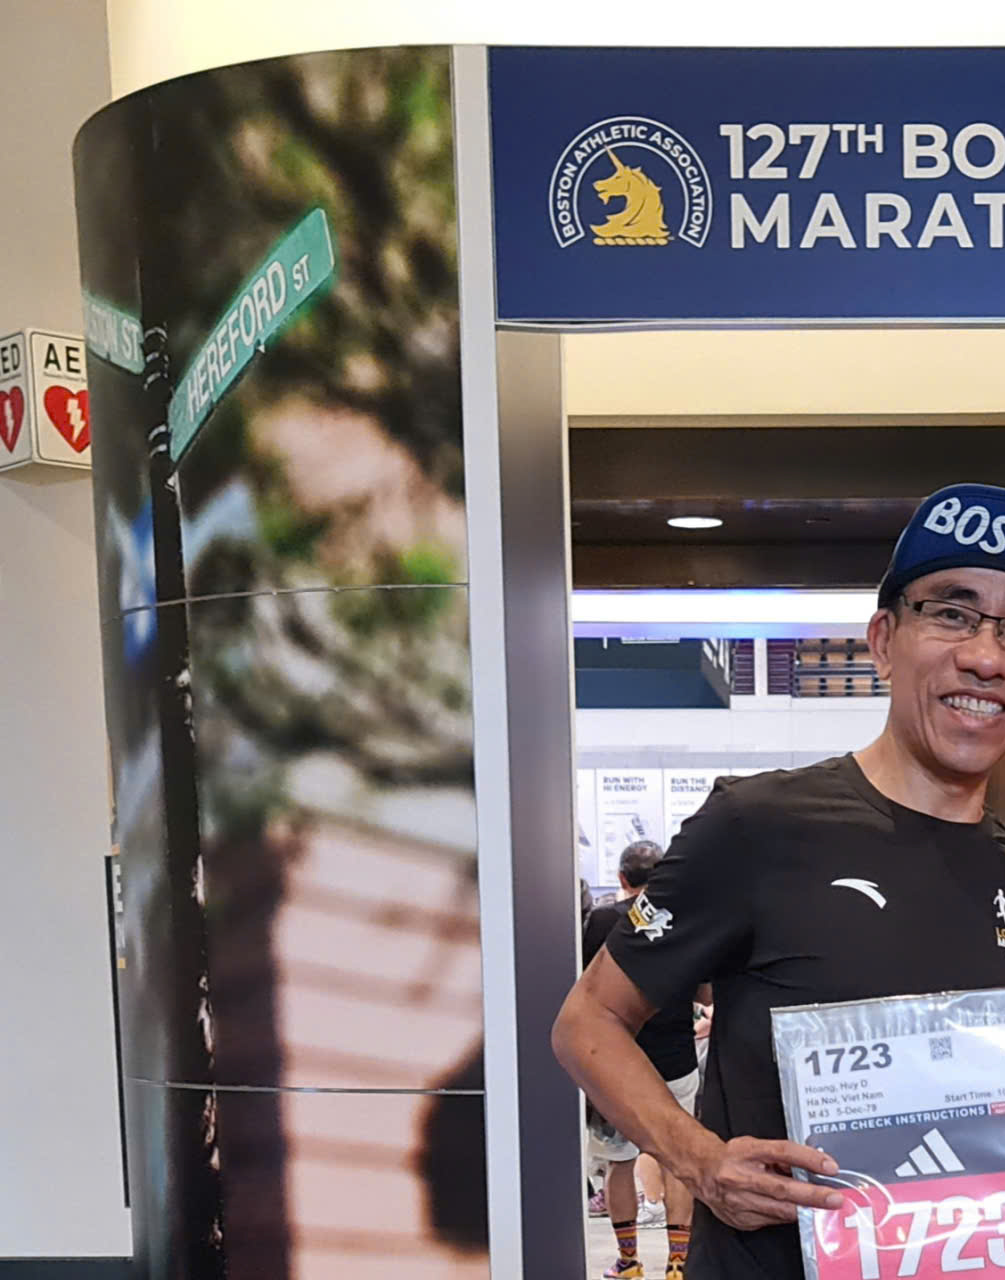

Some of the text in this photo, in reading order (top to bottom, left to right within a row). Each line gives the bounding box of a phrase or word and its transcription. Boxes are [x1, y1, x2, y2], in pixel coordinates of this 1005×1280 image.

[719, 123, 884, 179] 127TH
[557, 124, 705, 238] BOSTON ATHLETIC ASSOCIATION
[187, 254, 309, 422] HEREFORD ST
[805, 1042, 892, 1076] 1723
[814, 1122, 846, 1134] GEAR
[851, 1117, 892, 1130] CHECK
[896, 1105, 985, 1123] INSTRUCTIONS
[944, 1093, 967, 1103] Start
